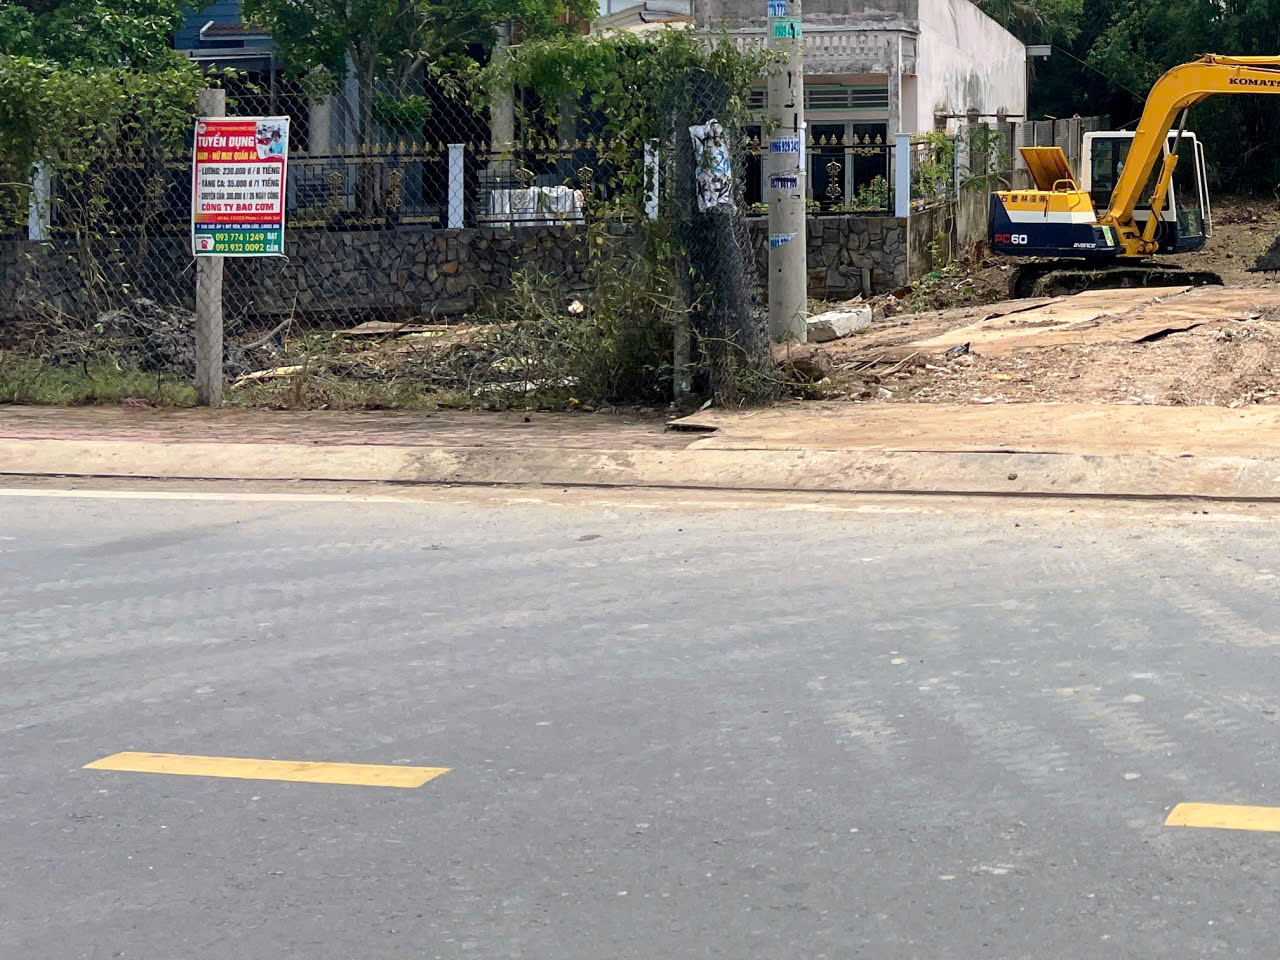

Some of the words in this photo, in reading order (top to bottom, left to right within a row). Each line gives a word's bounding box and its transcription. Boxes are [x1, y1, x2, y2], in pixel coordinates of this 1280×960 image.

[228, 136, 255, 150] DỤNG
[202, 202, 221, 211] CÔNG
[224, 203, 234, 211] TY
[236, 203, 252, 211] BAO
[216, 233, 228, 241] 093
[230, 233, 243, 241] 774
[246, 233, 265, 241] 1249
[994, 233, 1027, 244] PC60
[216, 243, 228, 251] 093
[230, 243, 243, 251] 932
[245, 243, 264, 251] 0092
